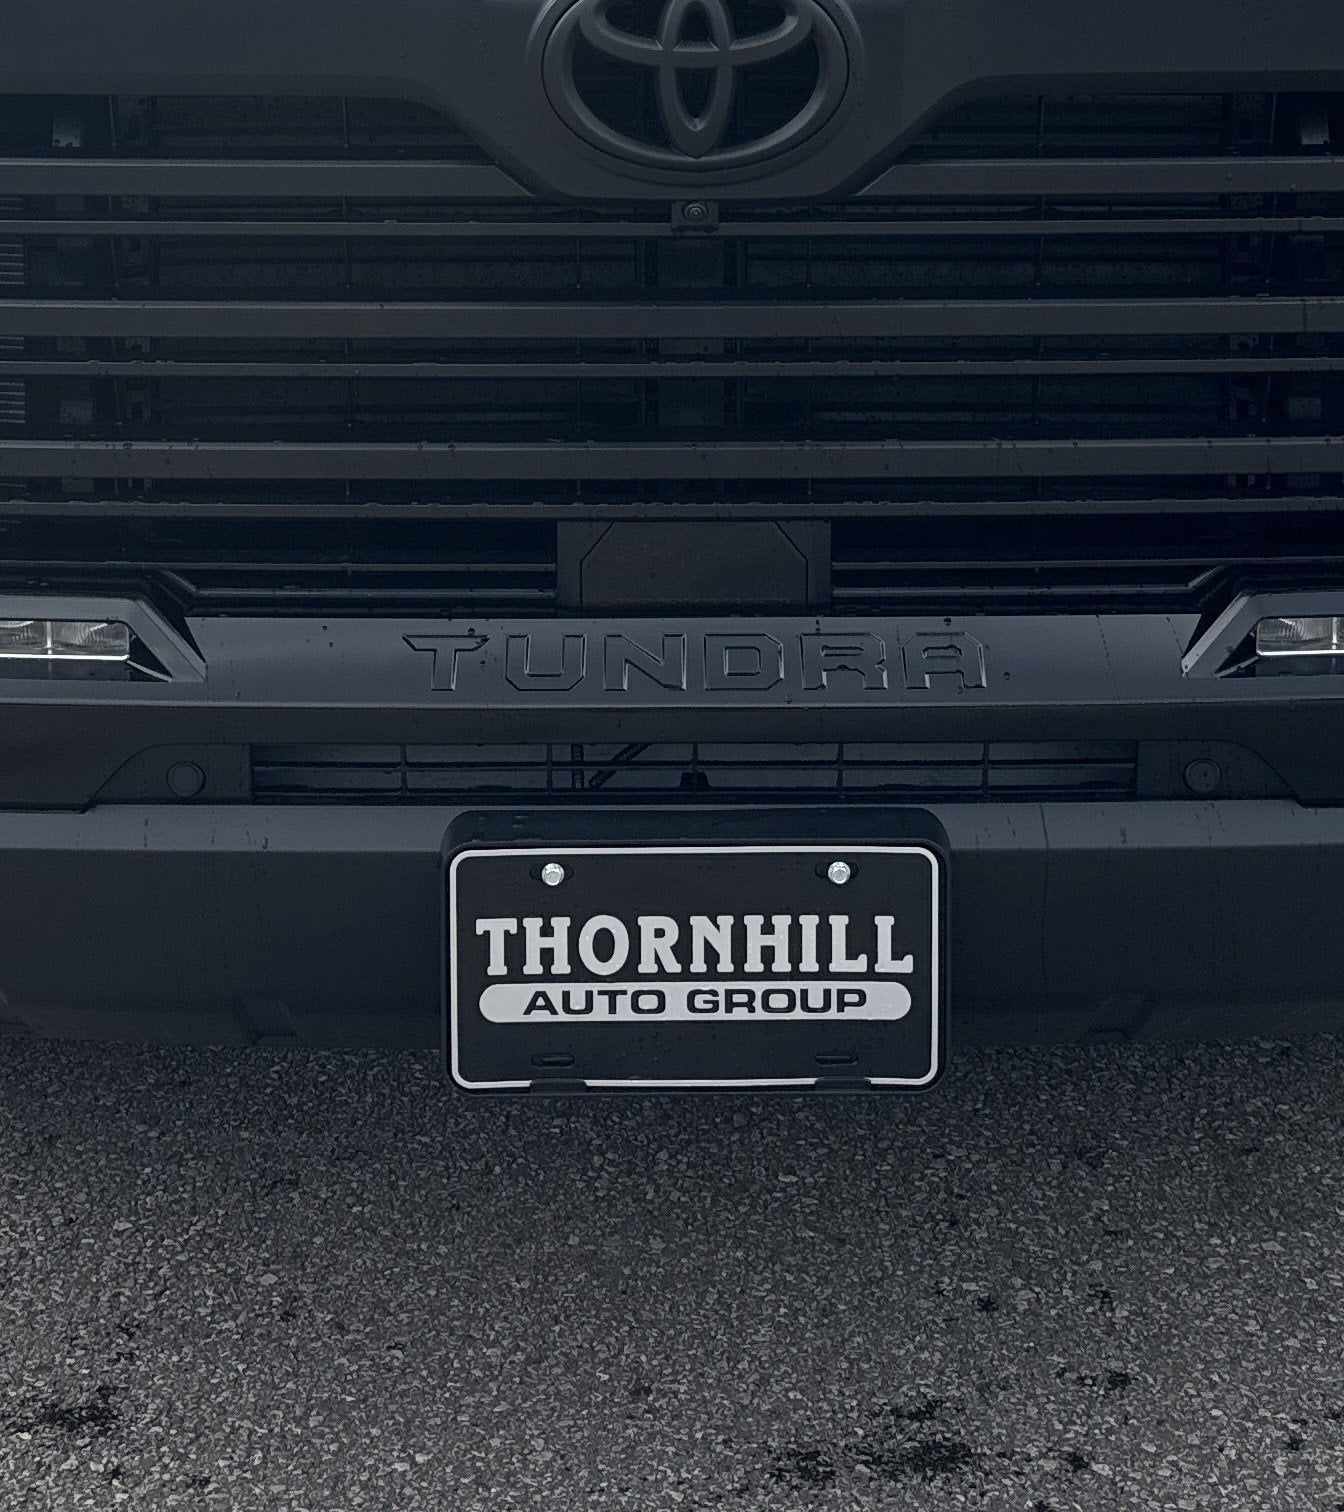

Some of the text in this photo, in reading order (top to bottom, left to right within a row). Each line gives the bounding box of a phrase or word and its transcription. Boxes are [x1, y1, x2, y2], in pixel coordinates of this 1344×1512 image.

[401, 631, 988, 692] TUNDRA
[475, 913, 915, 976] THORNHILL
[522, 987, 868, 1016] AUTO GROUP
